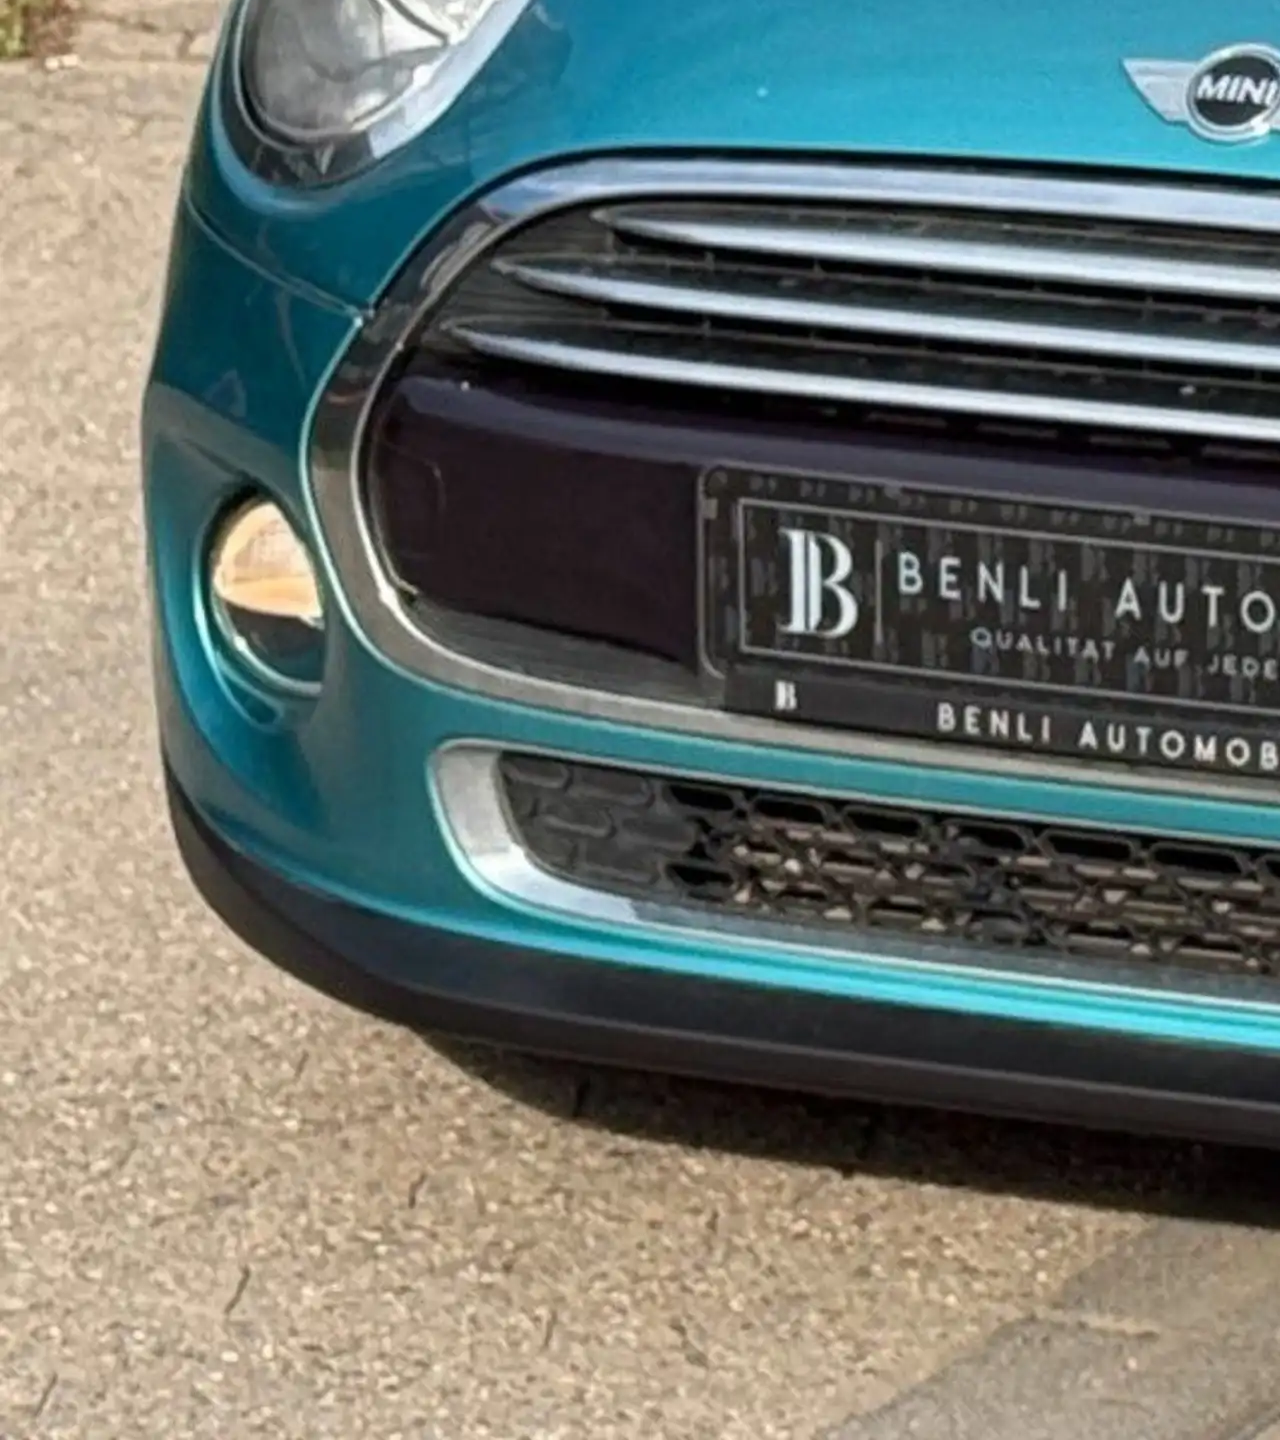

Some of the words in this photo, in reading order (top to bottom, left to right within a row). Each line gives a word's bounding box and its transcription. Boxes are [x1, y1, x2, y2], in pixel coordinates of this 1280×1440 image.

[1196, 74, 1278, 106] MINI
[897, 551, 1067, 613] BENLI
[1133, 645, 1189, 669] AUF
[936, 702, 1051, 744] BENLI
